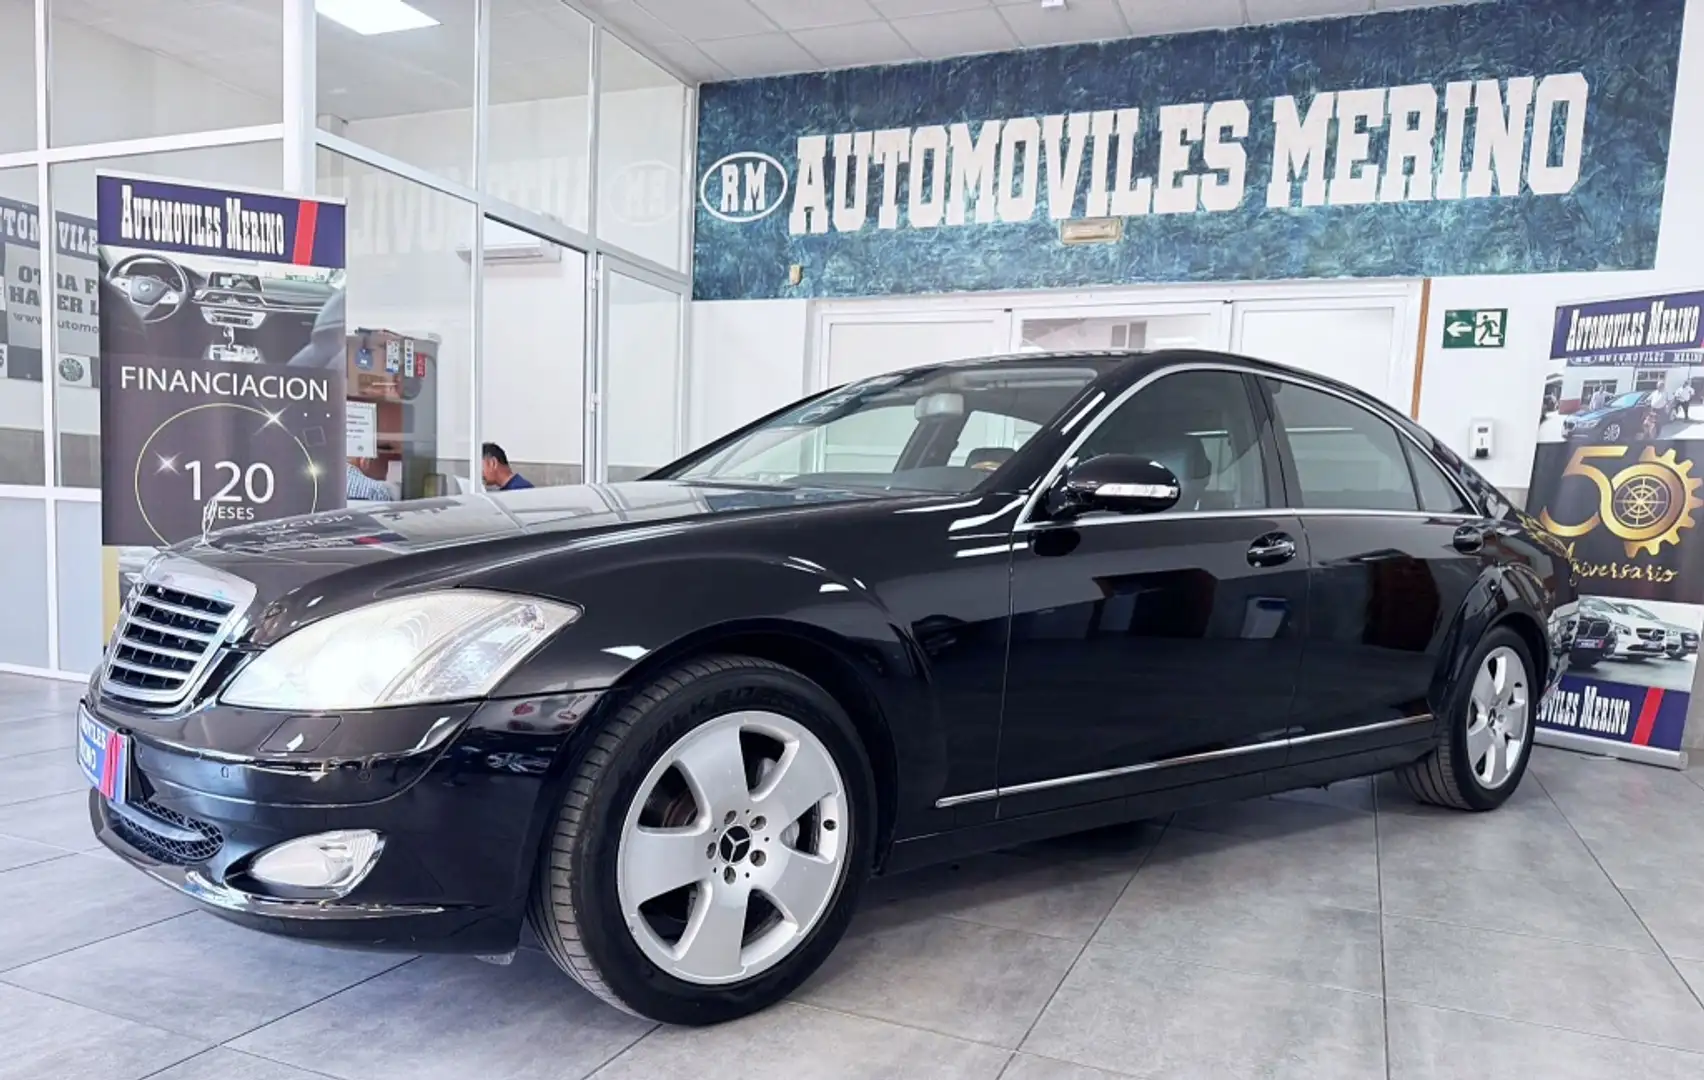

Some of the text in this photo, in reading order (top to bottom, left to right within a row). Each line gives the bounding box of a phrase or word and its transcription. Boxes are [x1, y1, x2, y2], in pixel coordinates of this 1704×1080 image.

[789, 72, 1588, 235] AUTOMOVILES MERINO
[720, 161, 766, 212] RM
[121, 184, 285, 255] AUTOMOVILES MERINO
[8, 285, 83, 314] HAER
[1566, 300, 1700, 352] AUTOMOVILES MERINO
[121, 366, 328, 402] FINANCIACION
[185, 460, 275, 504] 120
[1580, 685, 1630, 735] MERINO
